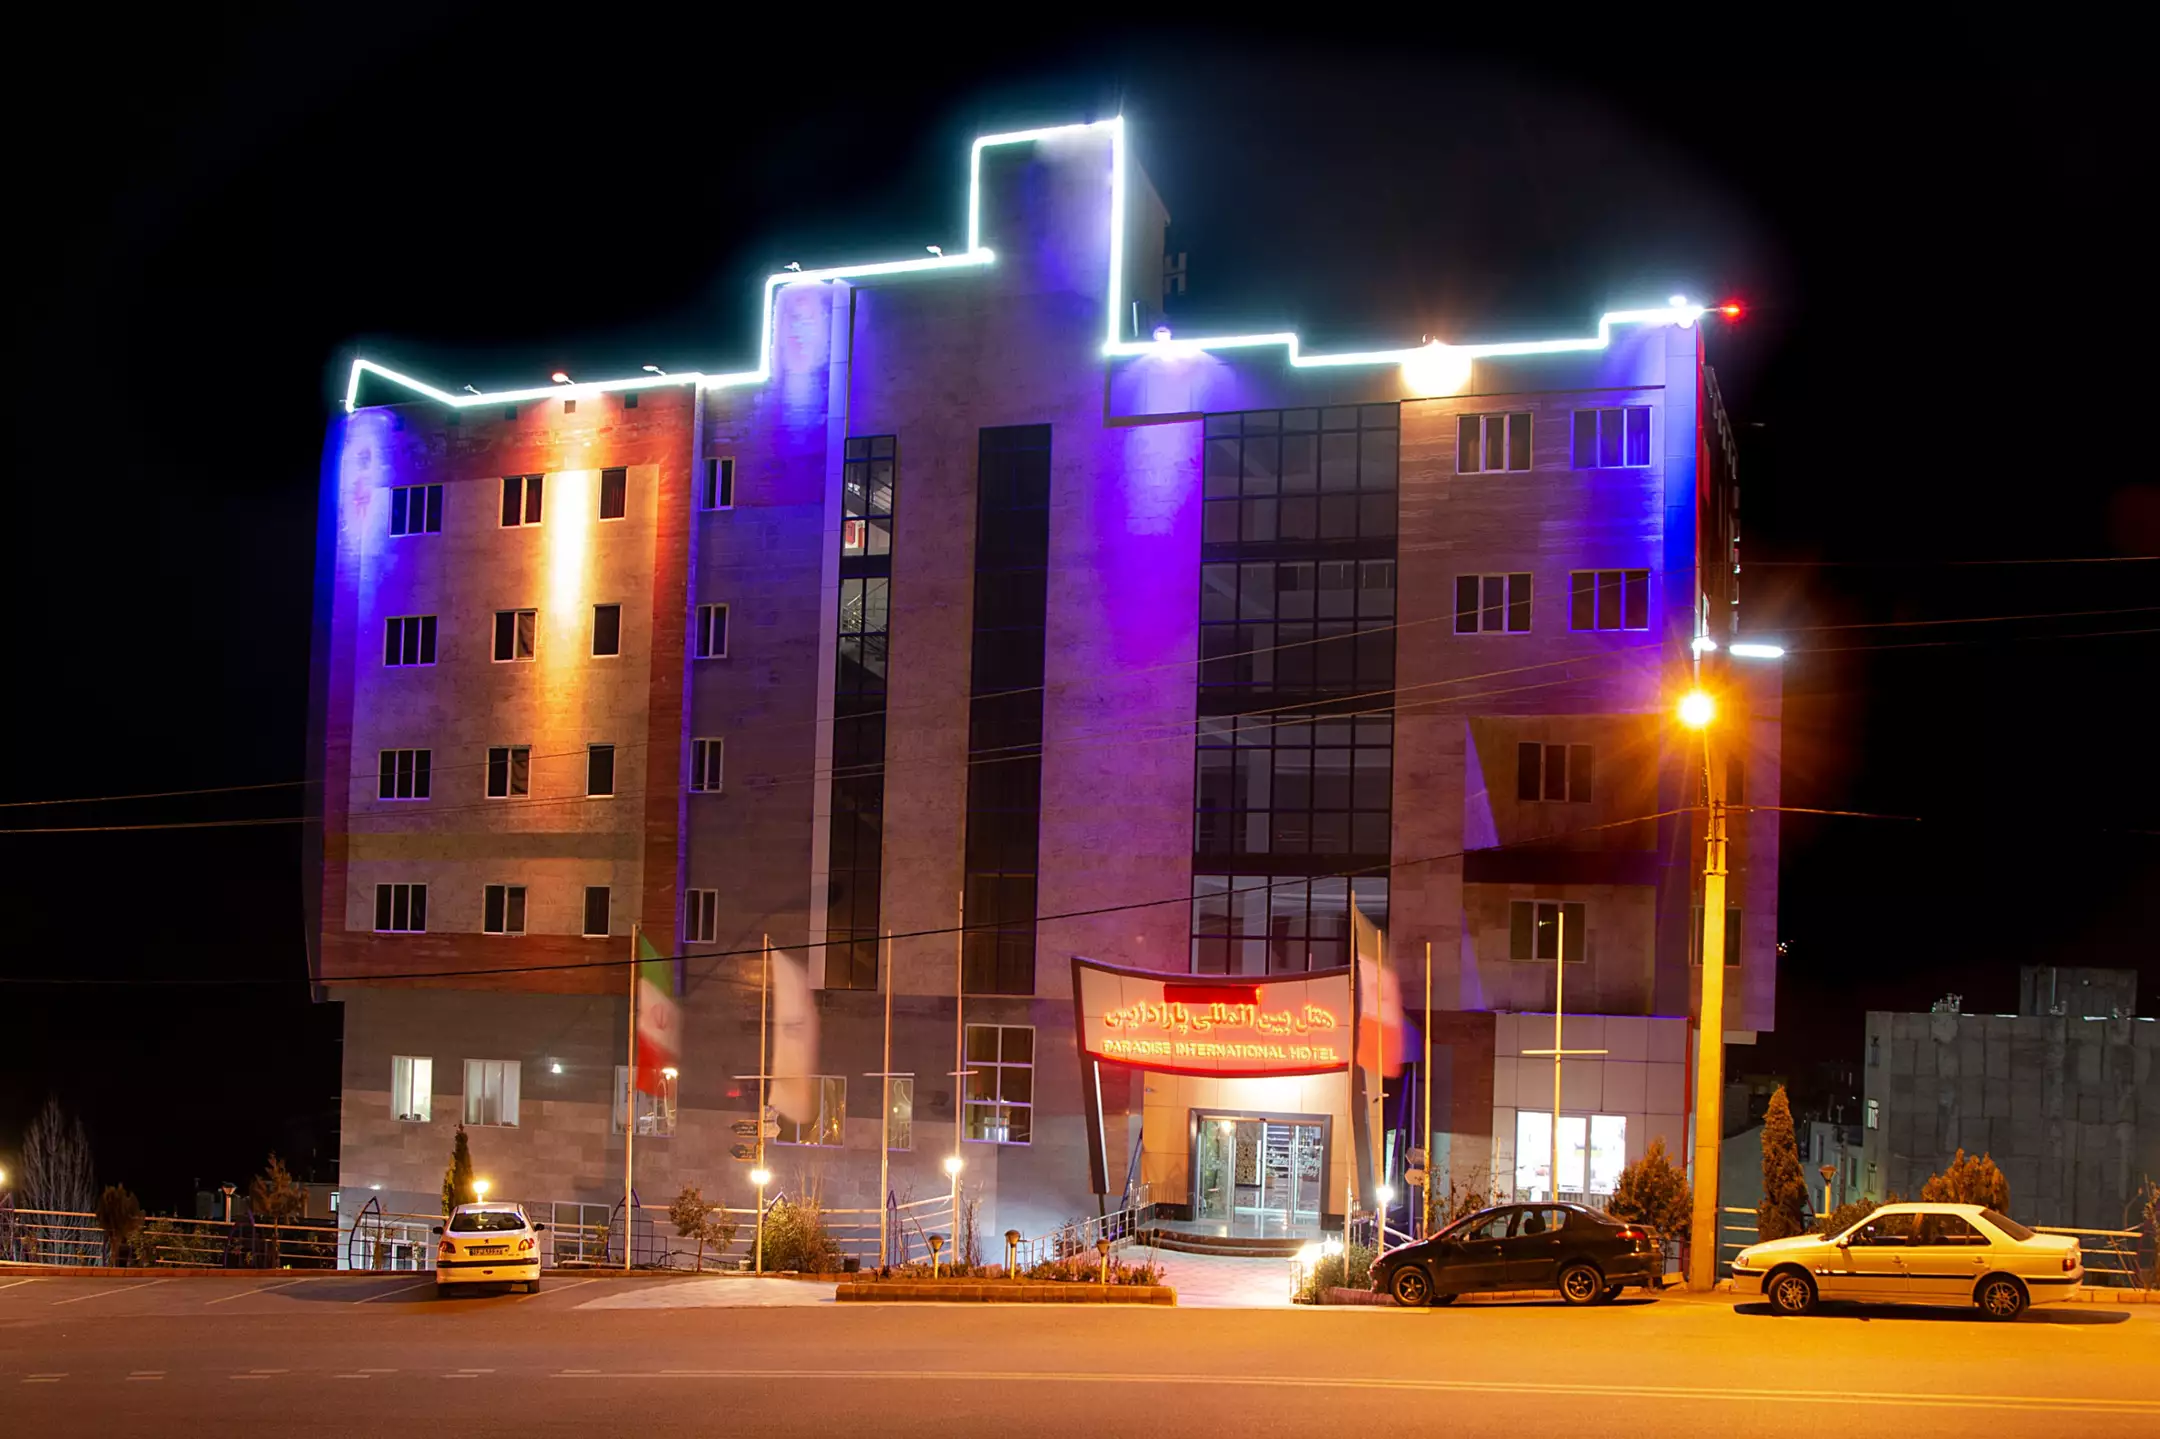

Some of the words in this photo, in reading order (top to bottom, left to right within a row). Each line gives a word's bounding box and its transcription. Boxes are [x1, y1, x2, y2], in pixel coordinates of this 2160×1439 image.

[1103, 1000, 1190, 1036] پارادایس
[1295, 1003, 1336, 1034] هتل
[1102, 1039, 1172, 1055] PARADISE
[1174, 1041, 1287, 1060] INTERNATIONAL
[1288, 1045, 1339, 1061] HOTEL
